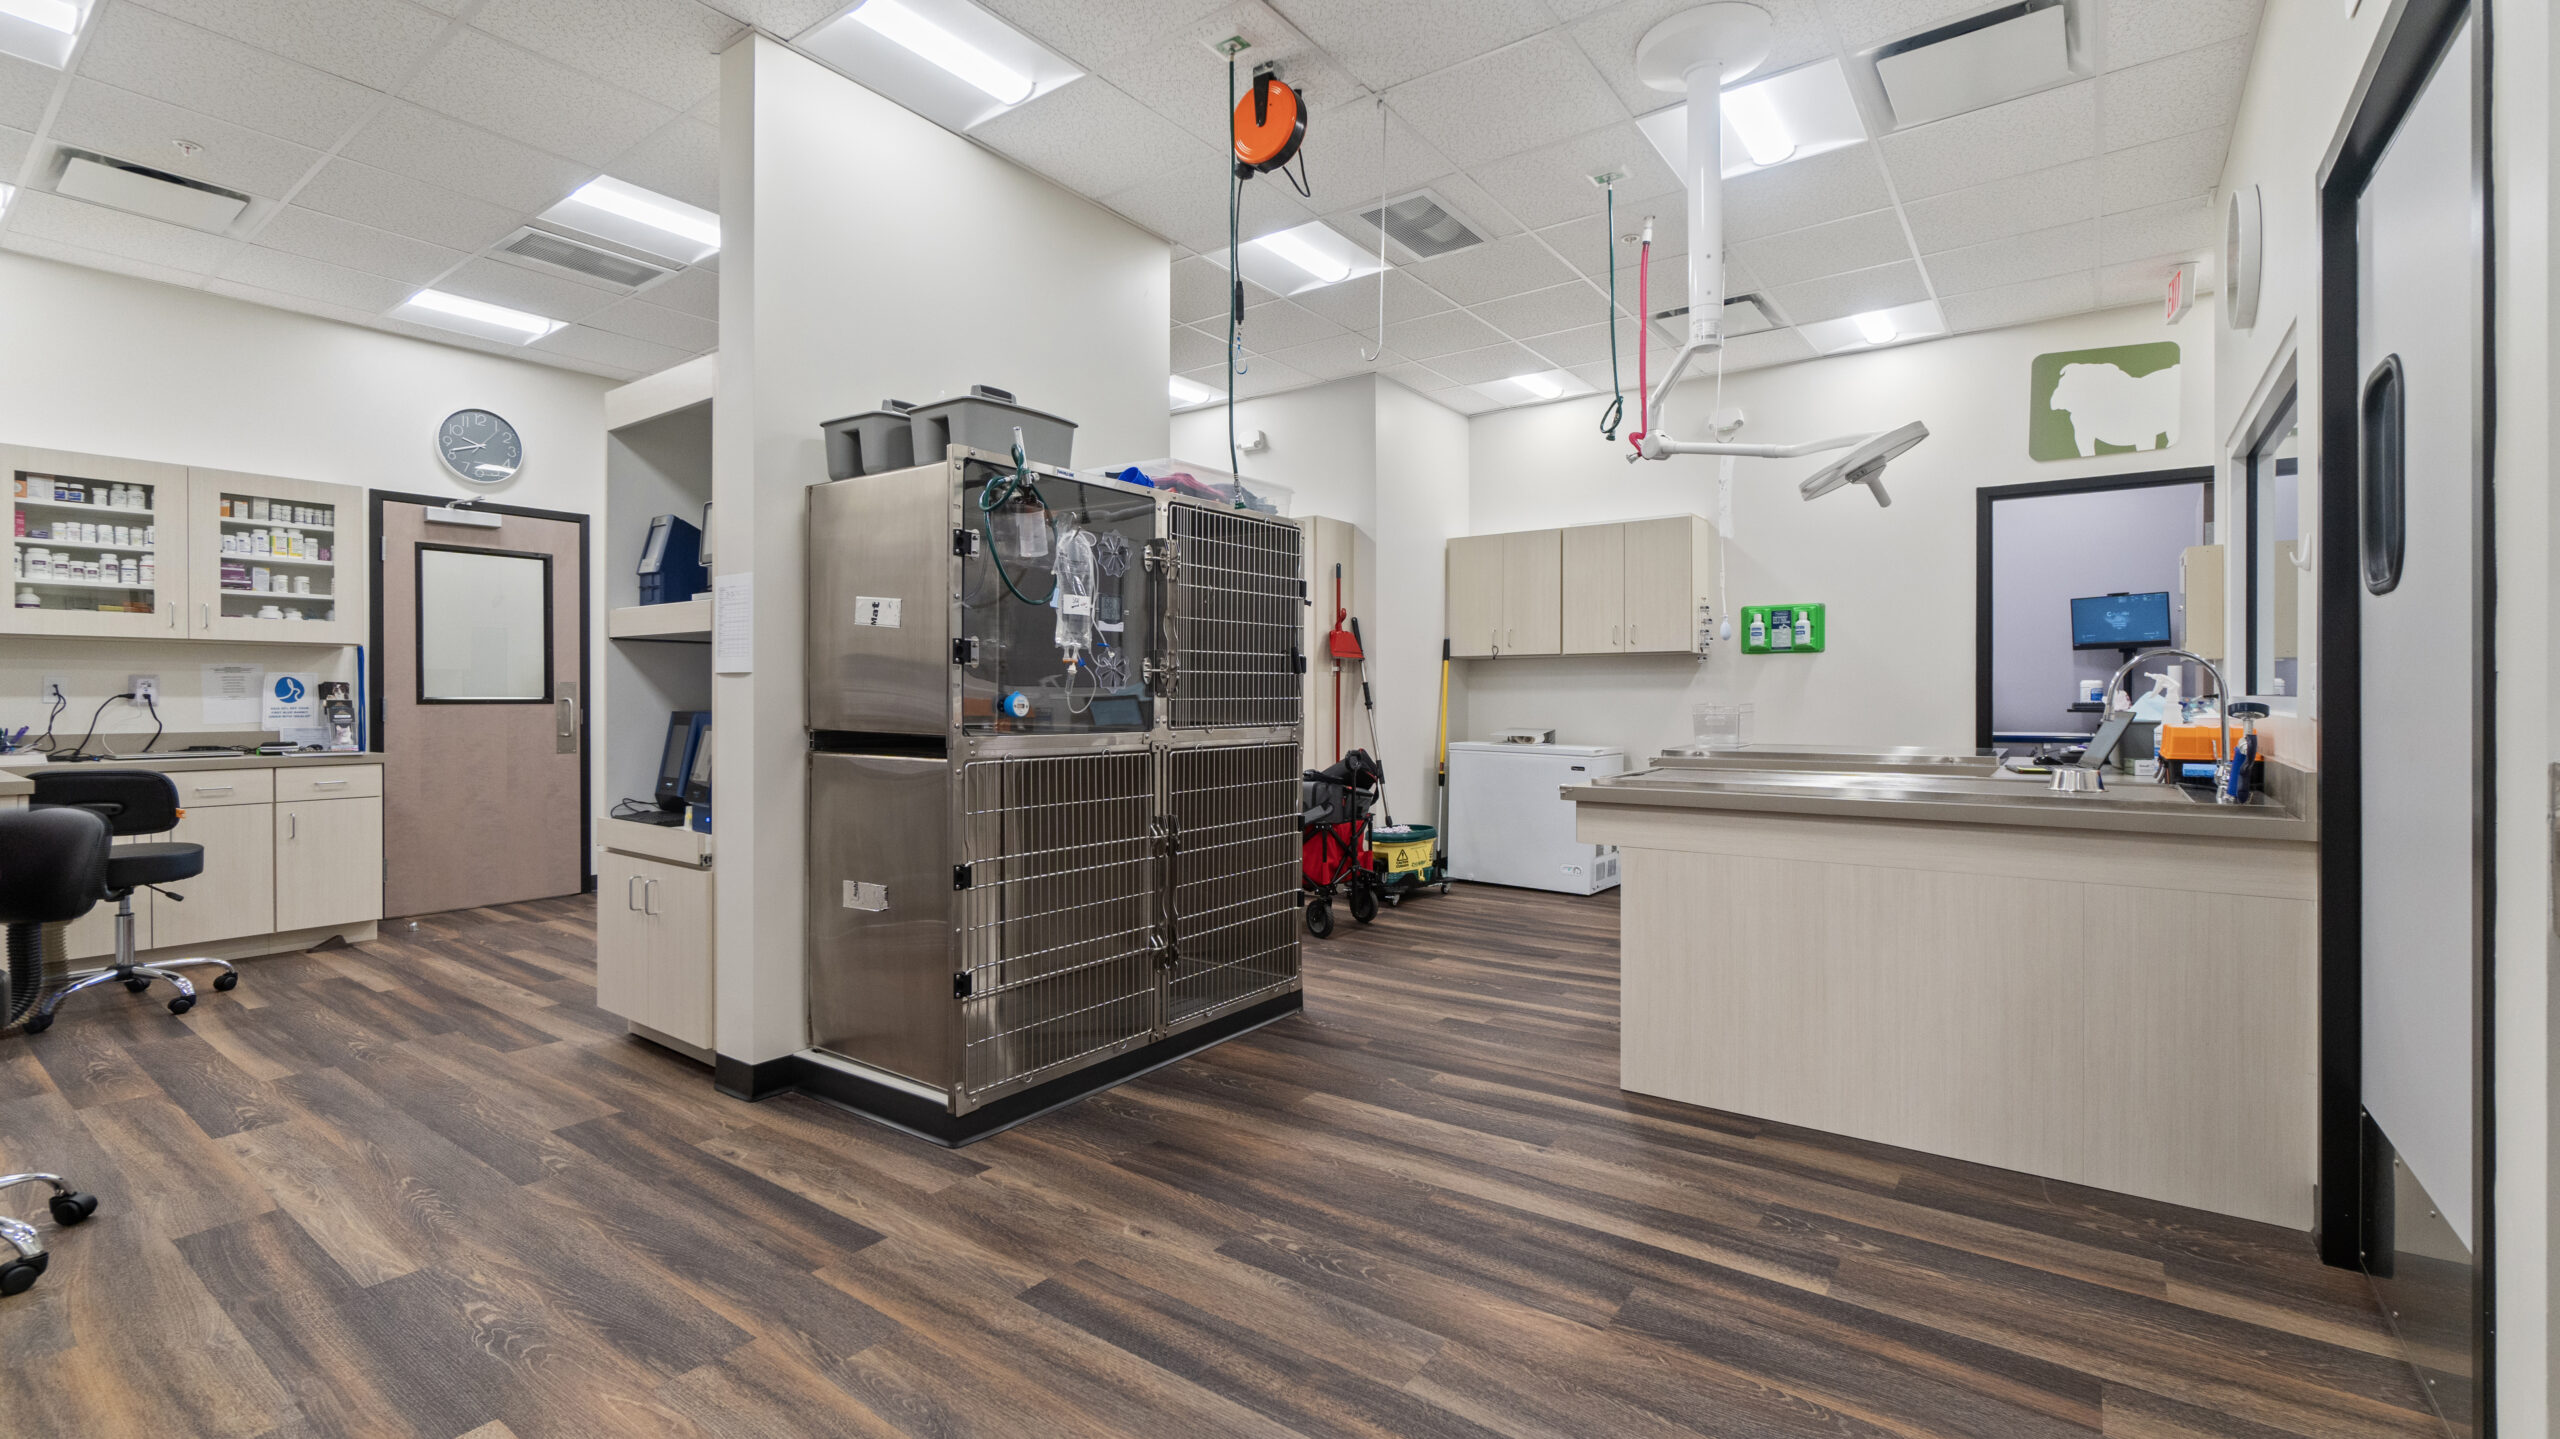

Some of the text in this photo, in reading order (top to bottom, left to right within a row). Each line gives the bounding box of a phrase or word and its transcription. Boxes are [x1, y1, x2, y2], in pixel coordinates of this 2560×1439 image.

[2168, 271, 2181, 319] EXIT
[462, 415, 470, 428] 11
[474, 413, 487, 426] 12
[449, 423, 464, 437] 10
[442, 435, 453, 447] 9
[502, 431, 512, 444] 2
[506, 446, 517, 458] 3
[461, 461, 471, 472] 7
